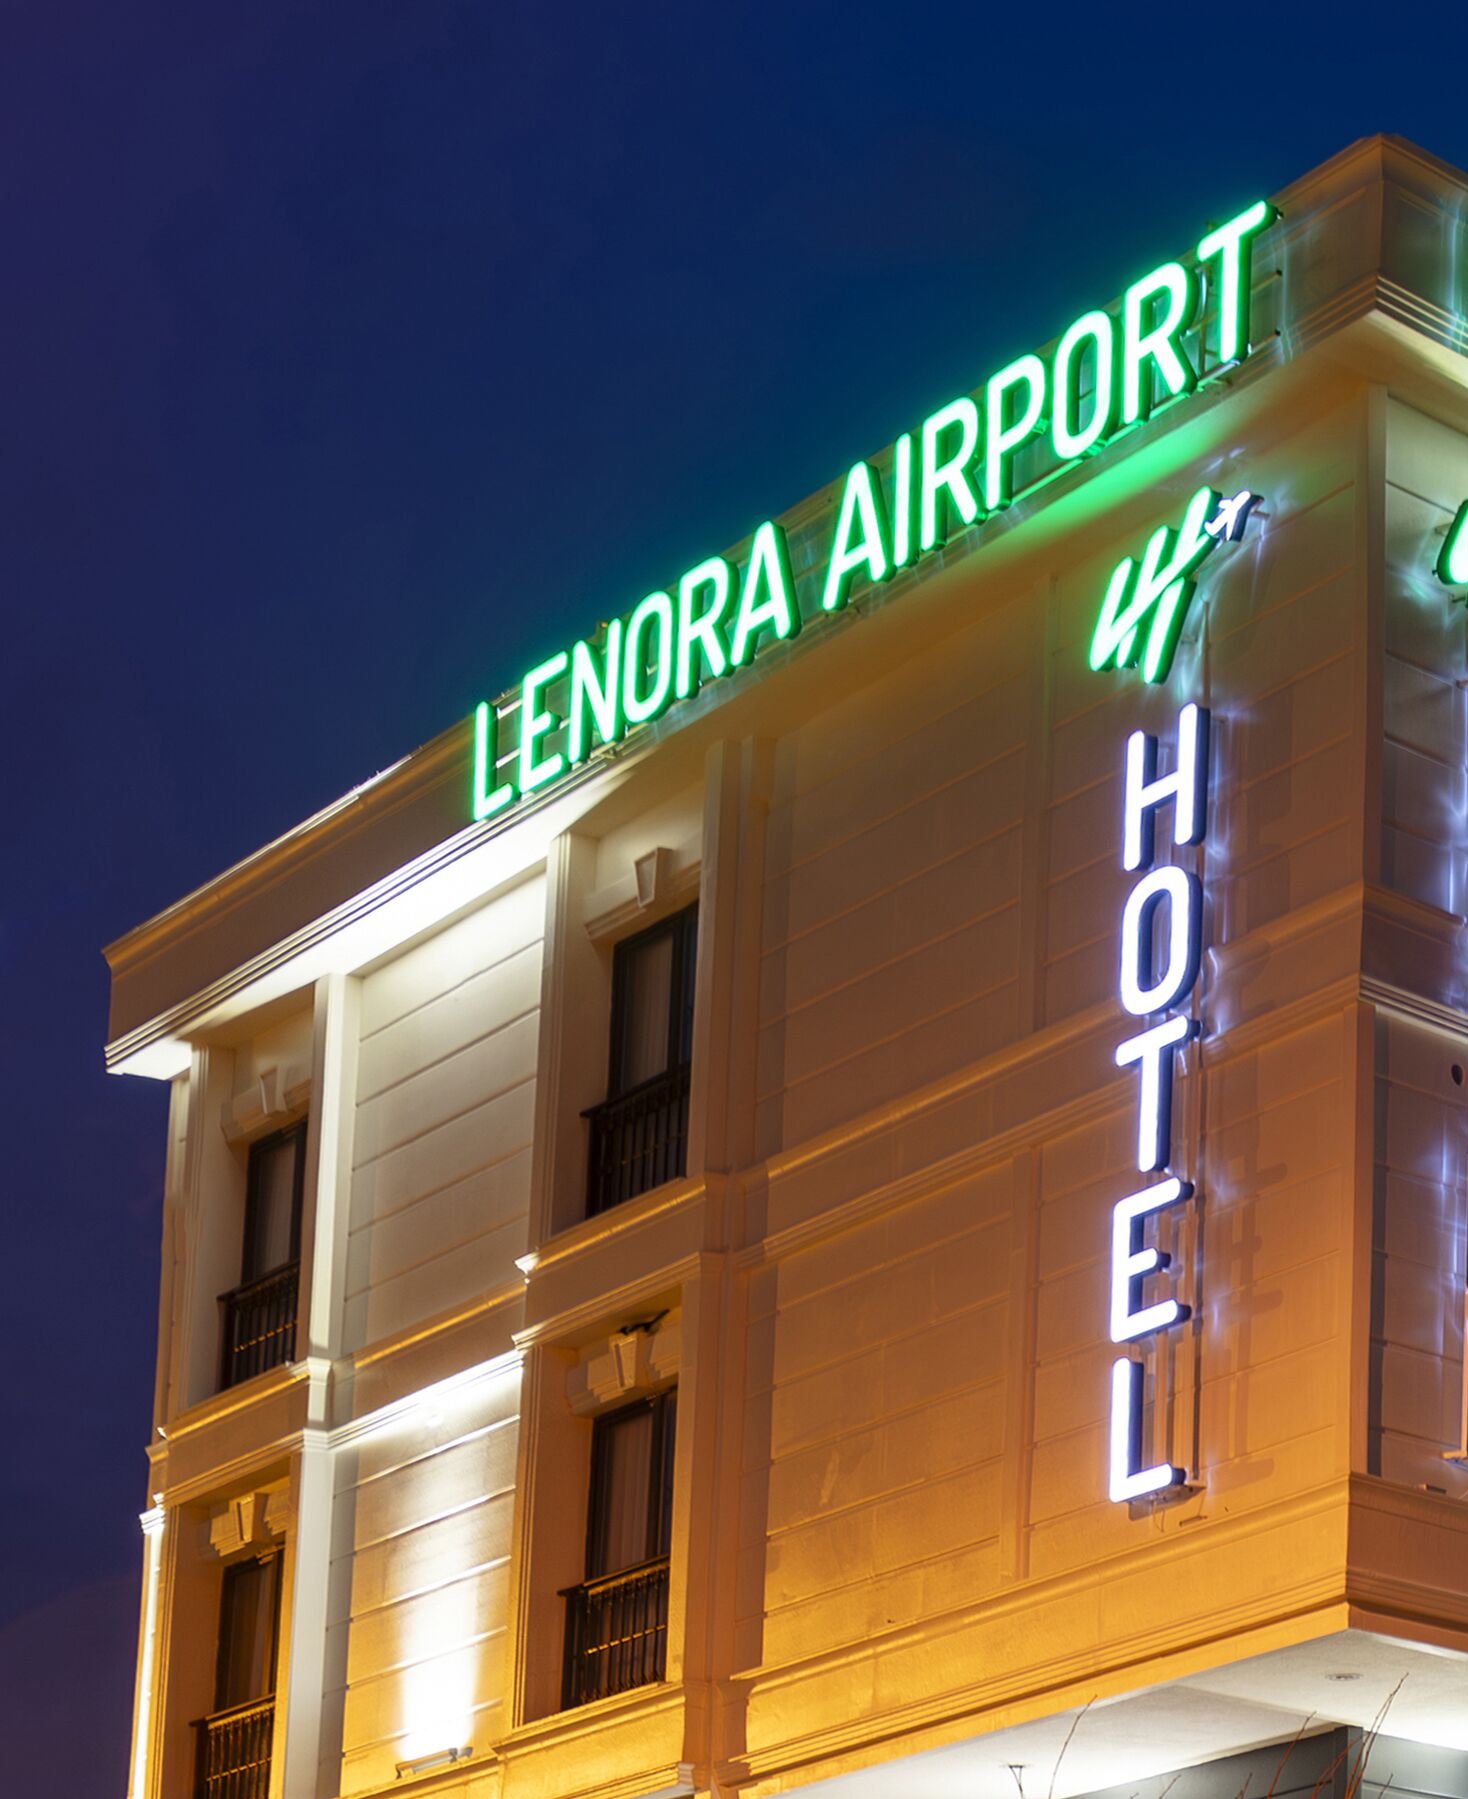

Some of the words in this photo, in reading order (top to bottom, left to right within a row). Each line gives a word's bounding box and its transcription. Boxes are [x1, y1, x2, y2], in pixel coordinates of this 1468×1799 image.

[473, 520, 795, 822] LENORA
[822, 200, 1272, 612] AIRPORT
[1109, 701, 1208, 1504] HOTEL
